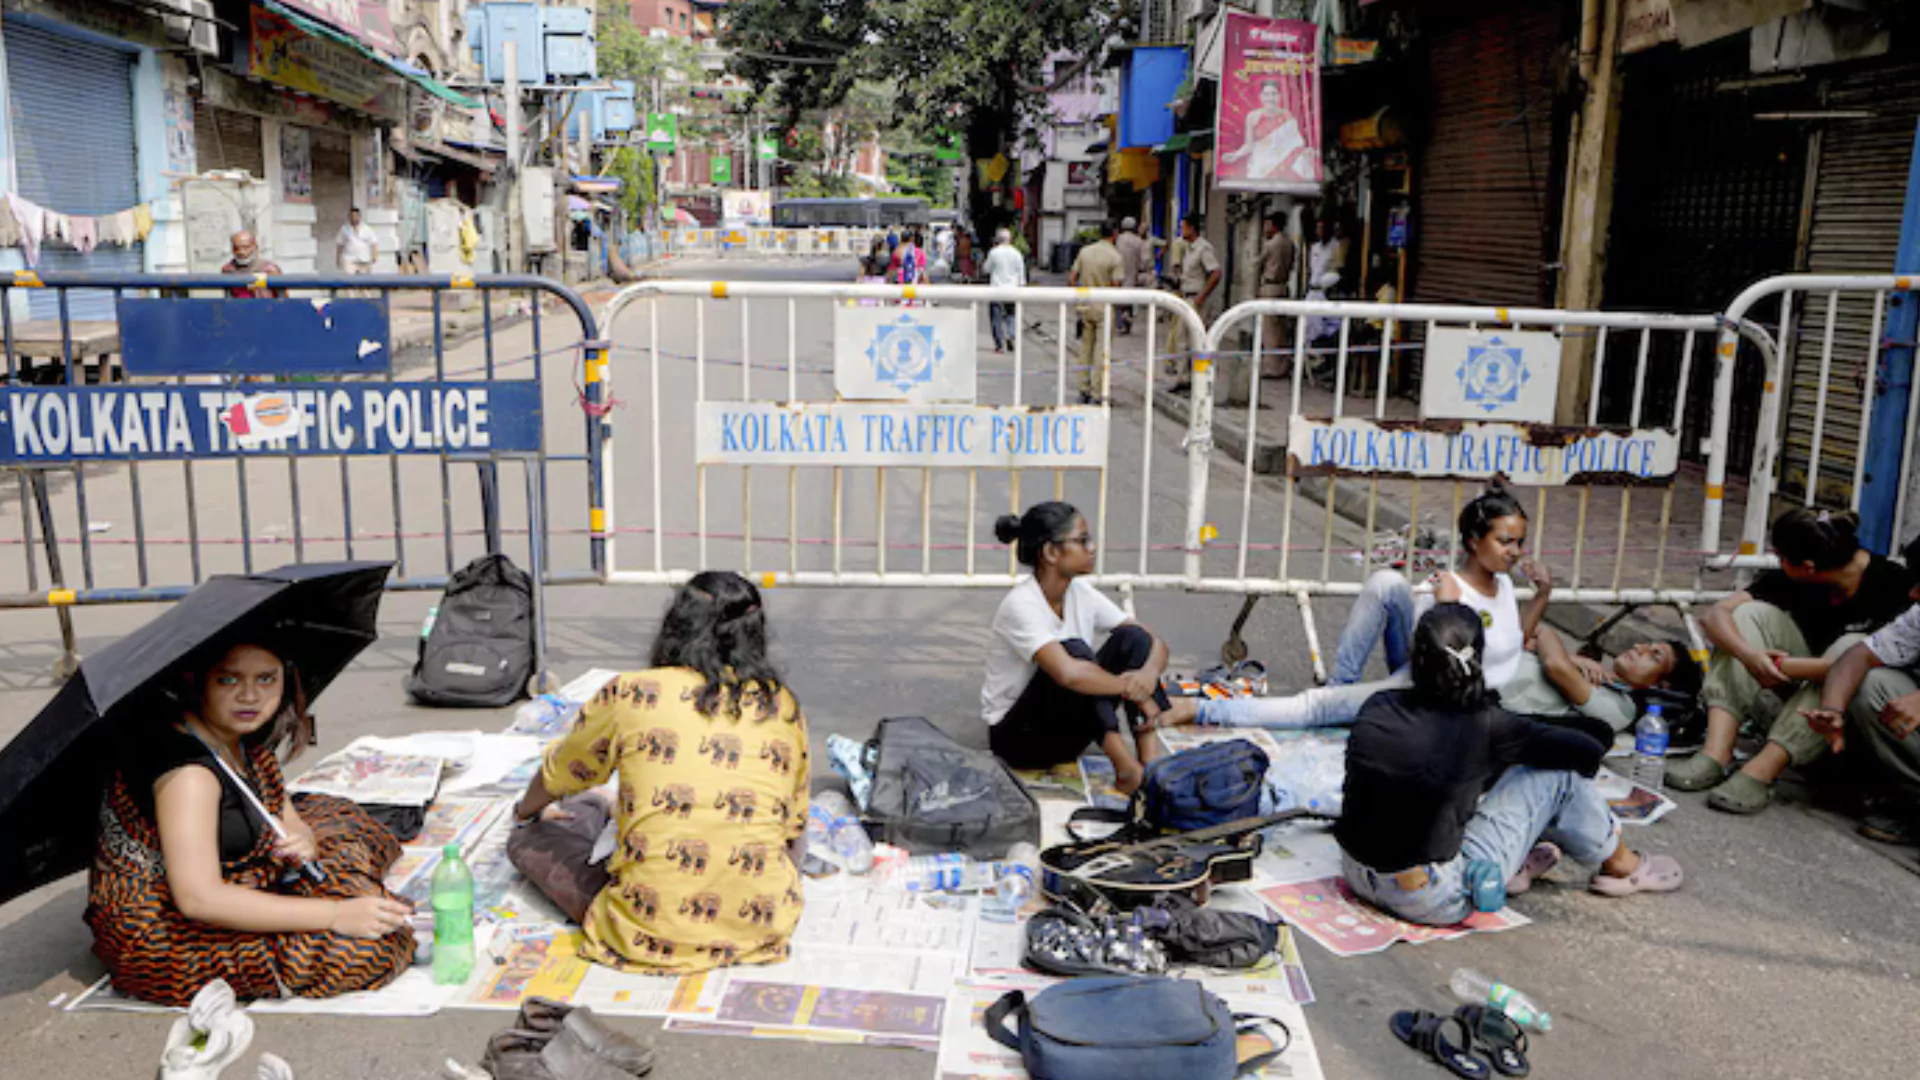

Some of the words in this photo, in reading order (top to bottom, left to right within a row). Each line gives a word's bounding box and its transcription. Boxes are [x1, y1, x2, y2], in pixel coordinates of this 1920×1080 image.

[10, 392, 194, 455] KOLKATA
[199, 389, 354, 452] TRFIC
[363, 388, 491, 450] POLICE
[721, 412, 847, 453] KOLKATA
[861, 414, 975, 455] TRAFFIC
[991, 415, 1085, 455] POLICE
[1310, 428, 1430, 471] KOLKATA
[1563, 437, 1656, 477] POLICE
